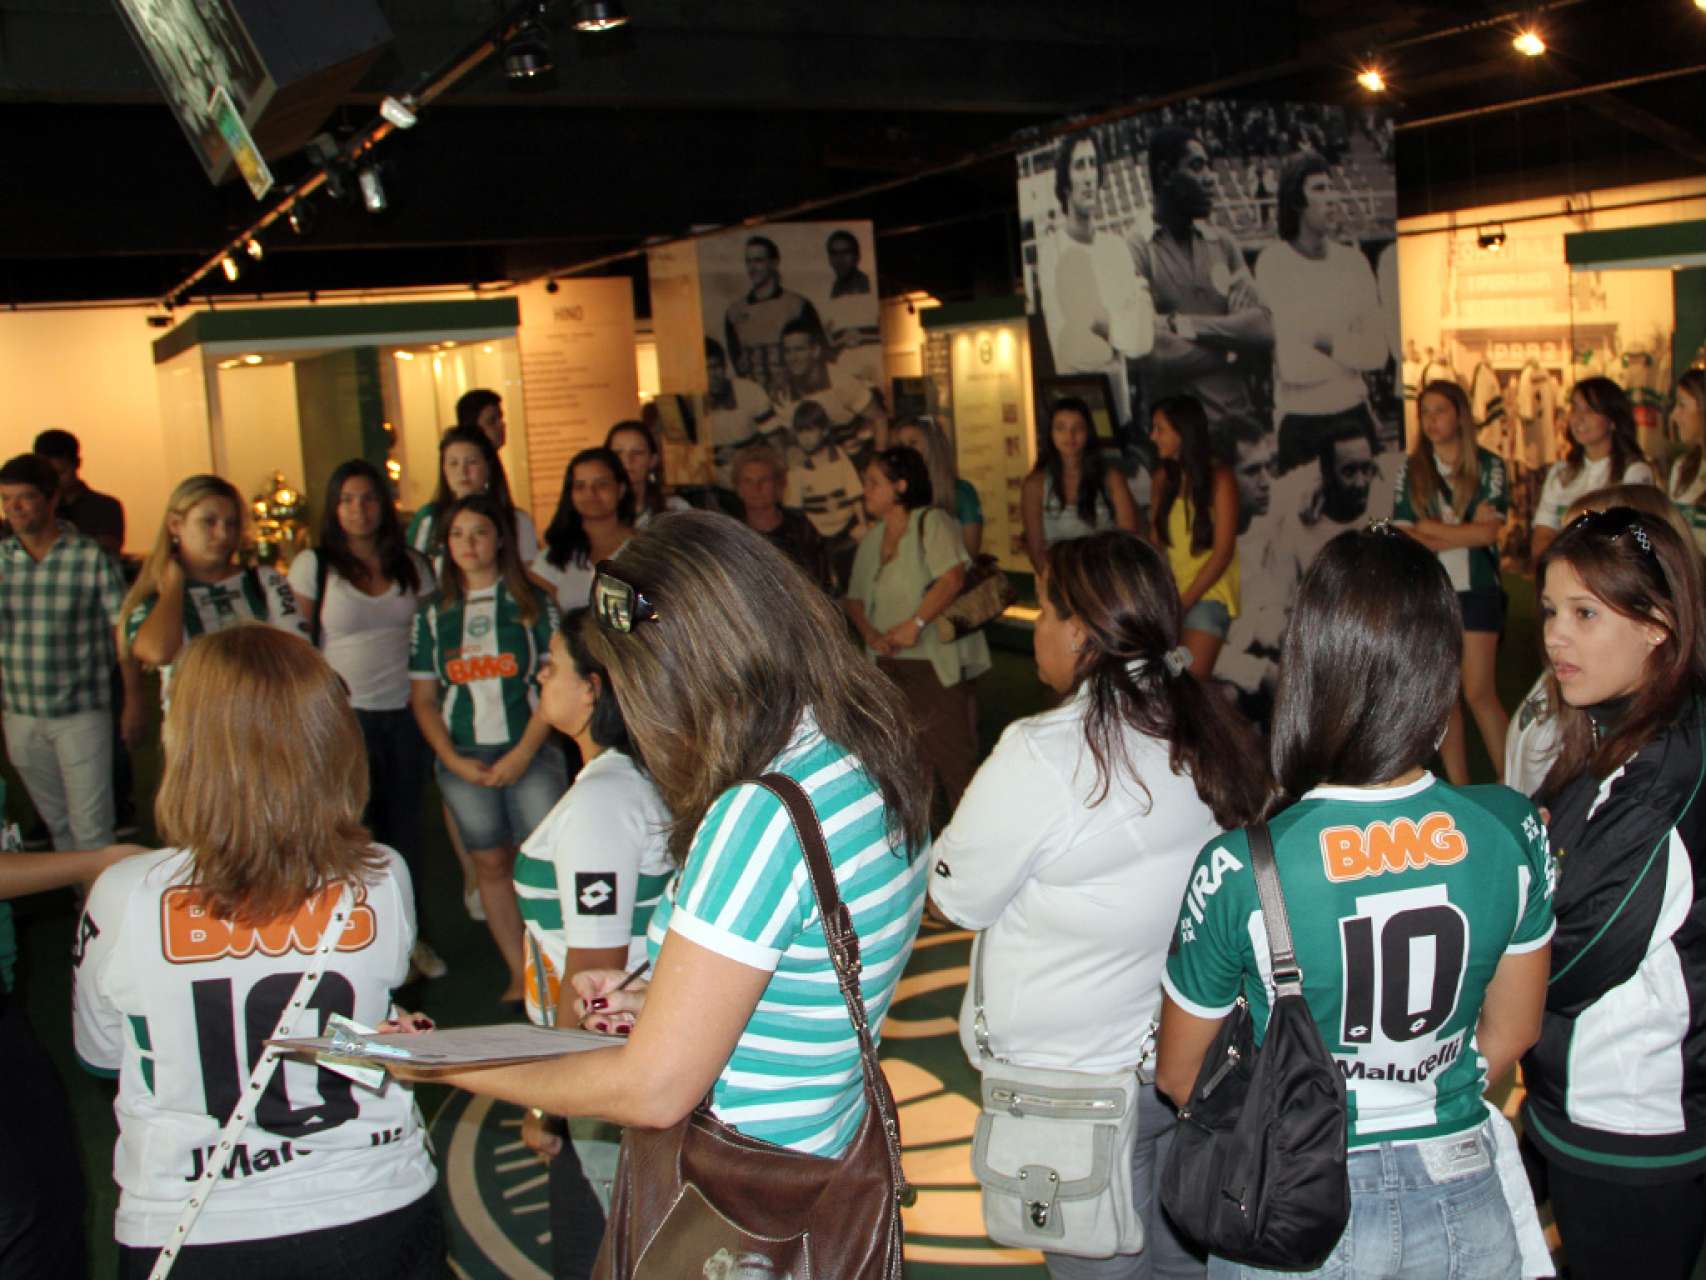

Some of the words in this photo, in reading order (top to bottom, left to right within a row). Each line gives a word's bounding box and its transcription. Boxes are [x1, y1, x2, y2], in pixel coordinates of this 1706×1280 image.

[1320, 812, 1467, 883] BMG
[1341, 904, 1469, 1044] 10
[191, 970, 360, 1139] 10
